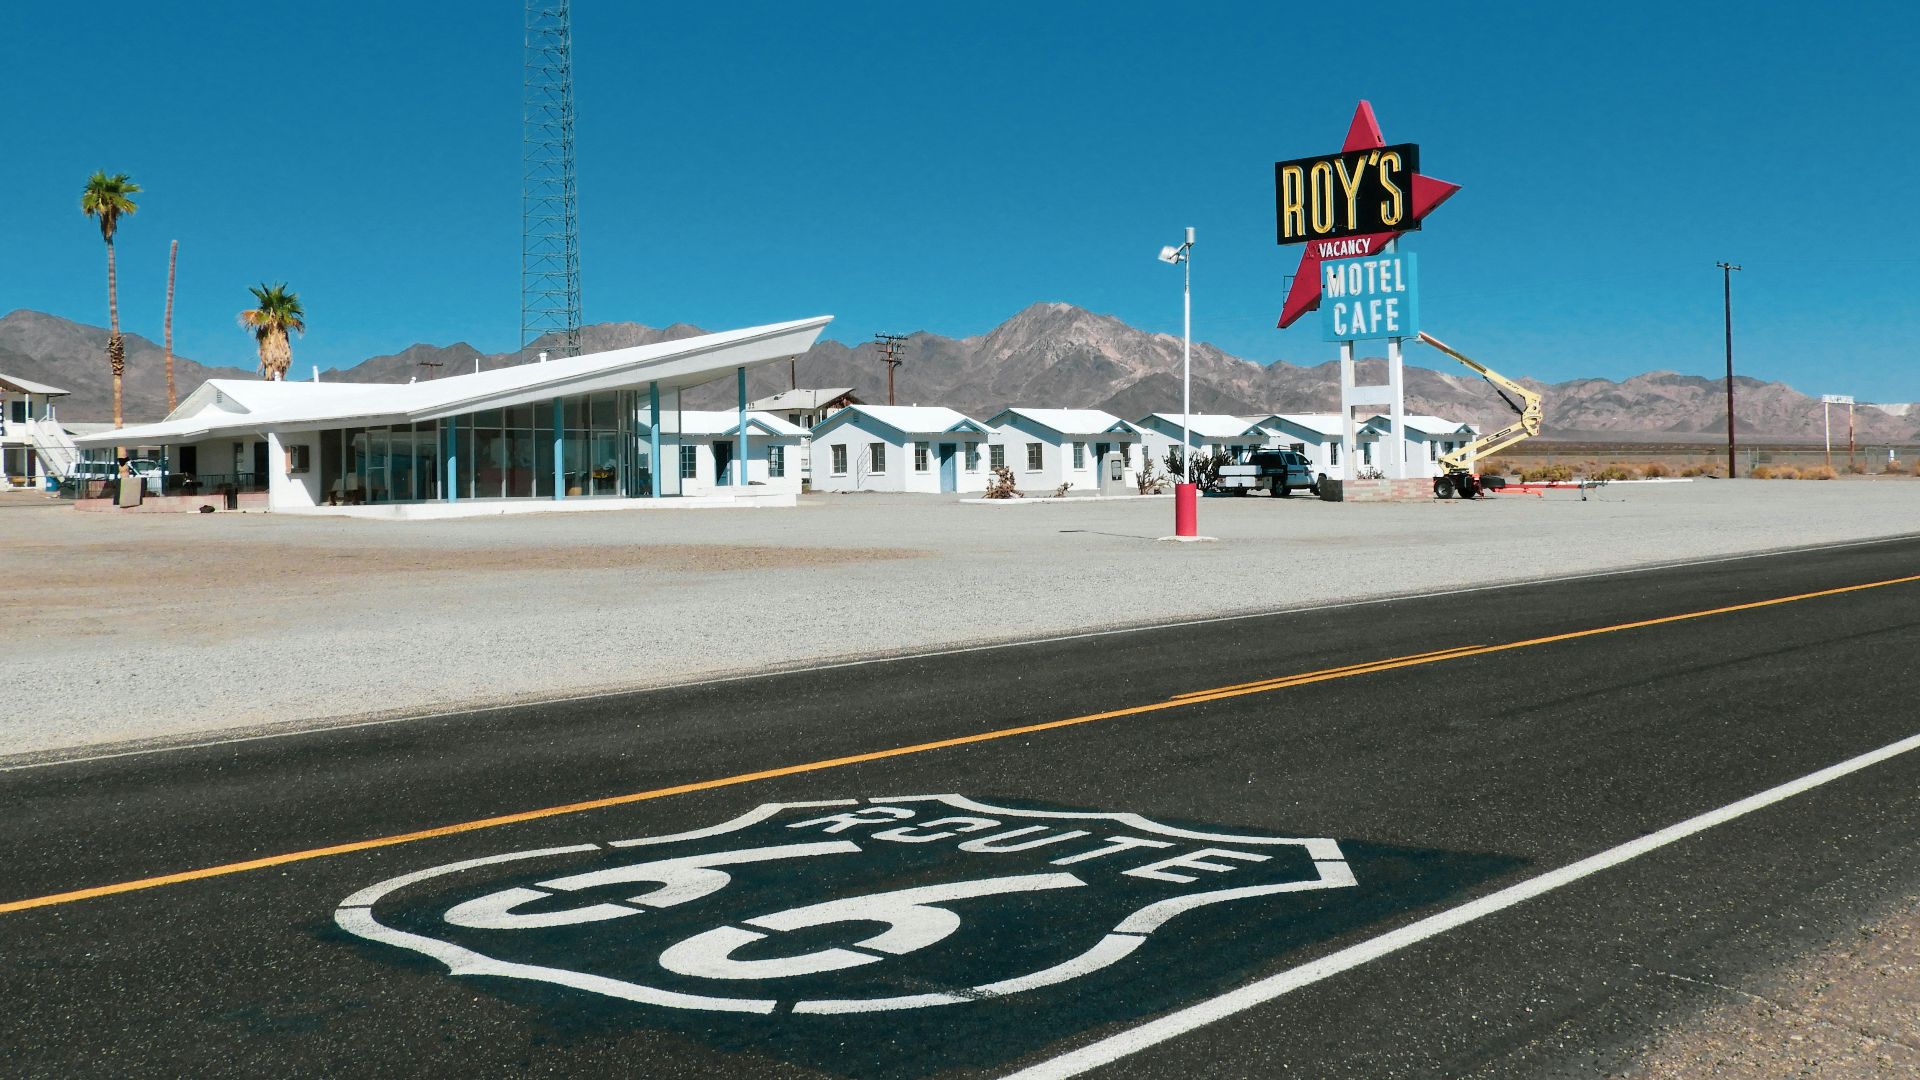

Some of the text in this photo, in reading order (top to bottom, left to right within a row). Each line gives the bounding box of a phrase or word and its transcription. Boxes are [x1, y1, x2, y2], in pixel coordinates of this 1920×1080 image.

[1282, 150, 1403, 238] ROY'S
[1319, 238, 1371, 258] VACANCY
[1326, 258, 1405, 298] MOTEL
[1334, 298, 1399, 336] CAFE
[787, 806, 1273, 883] ROUTE
[444, 840, 1088, 980] 66
